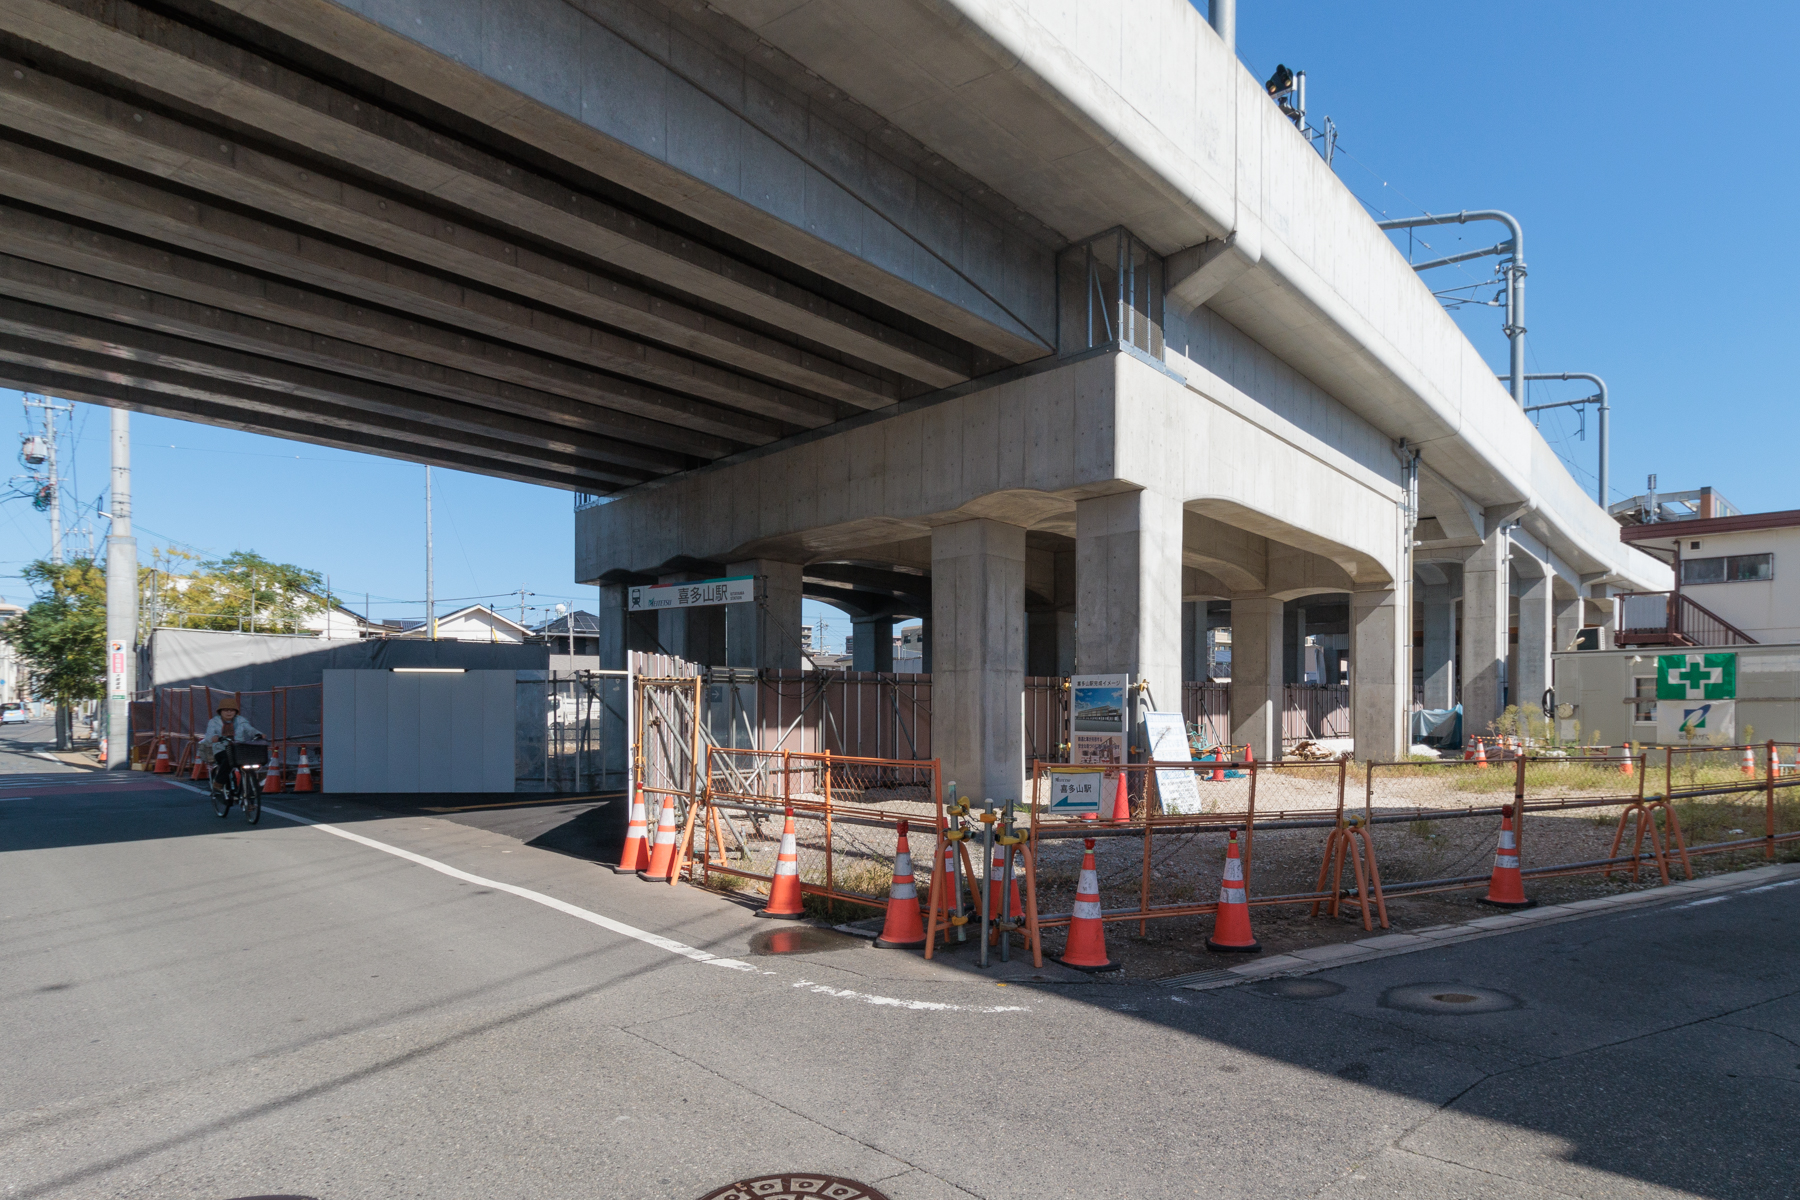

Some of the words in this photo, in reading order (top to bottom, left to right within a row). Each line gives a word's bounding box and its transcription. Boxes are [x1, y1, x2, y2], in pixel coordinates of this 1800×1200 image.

[677, 584, 728, 605] 喜多山駅
[1678, 733, 1710, 741] 安ハザマ
[1060, 784, 1092, 794] 喜多山駅
